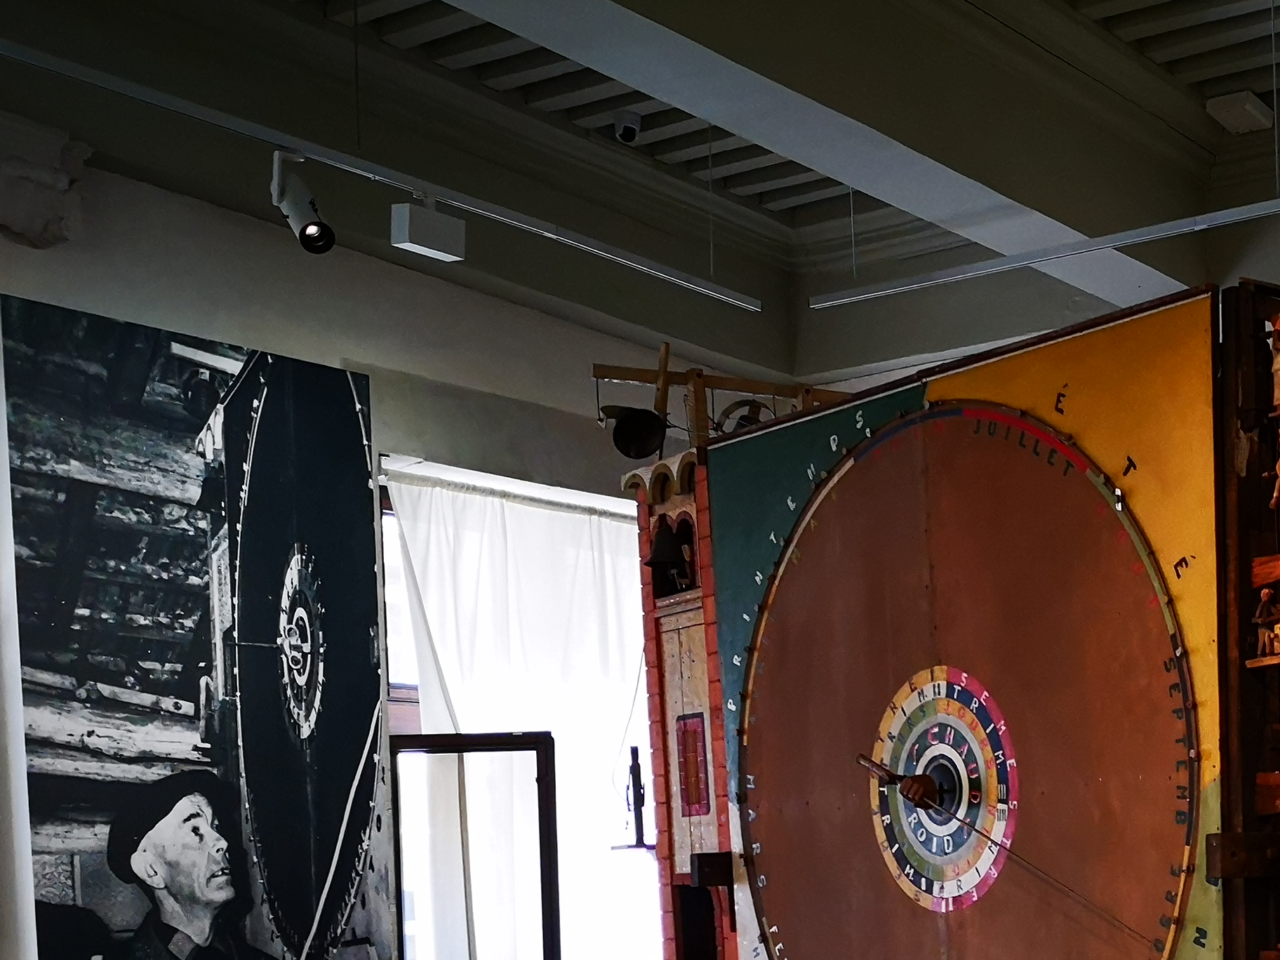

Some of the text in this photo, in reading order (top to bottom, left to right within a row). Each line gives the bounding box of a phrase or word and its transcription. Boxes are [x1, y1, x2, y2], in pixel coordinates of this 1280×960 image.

[974, 418, 1075, 477] JUILLET
[928, 725, 981, 804] CHAUD
[908, 813, 953, 853] ROID
